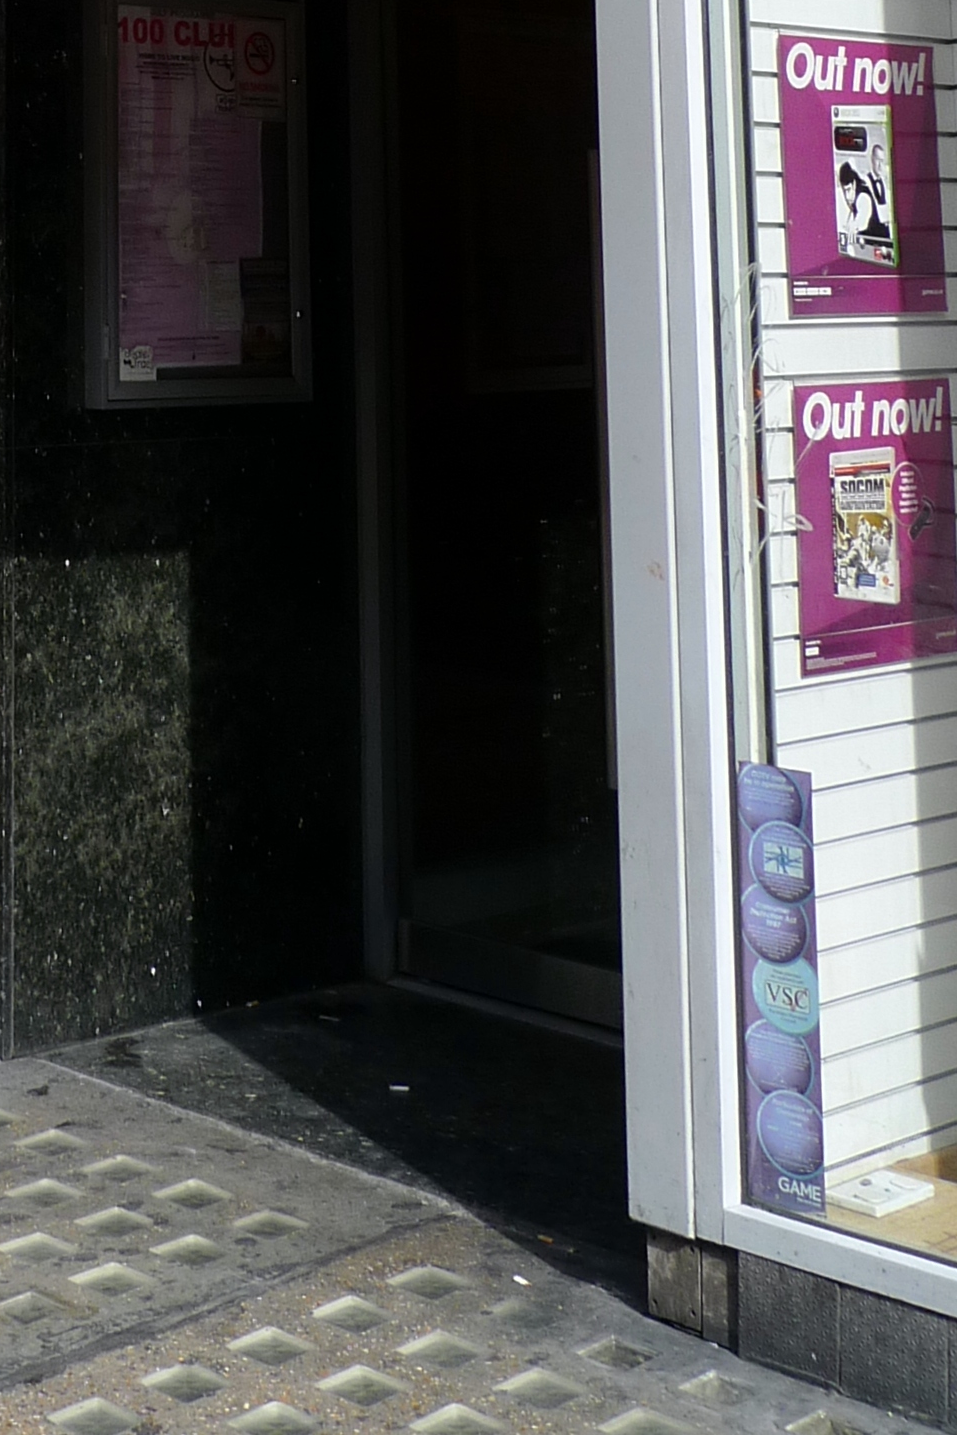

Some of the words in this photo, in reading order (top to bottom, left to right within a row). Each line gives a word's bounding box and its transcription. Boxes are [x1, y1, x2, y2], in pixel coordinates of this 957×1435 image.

[118, 16, 164, 45] 100
[786, 42, 847, 91] Out
[853, 52, 927, 96] now!
[803, 390, 865, 441] Out
[871, 386, 943, 437] now!
[840, 477, 885, 494] SOCOM
[766, 982, 808, 1010] VSC
[778, 1176, 821, 1203] GAME
